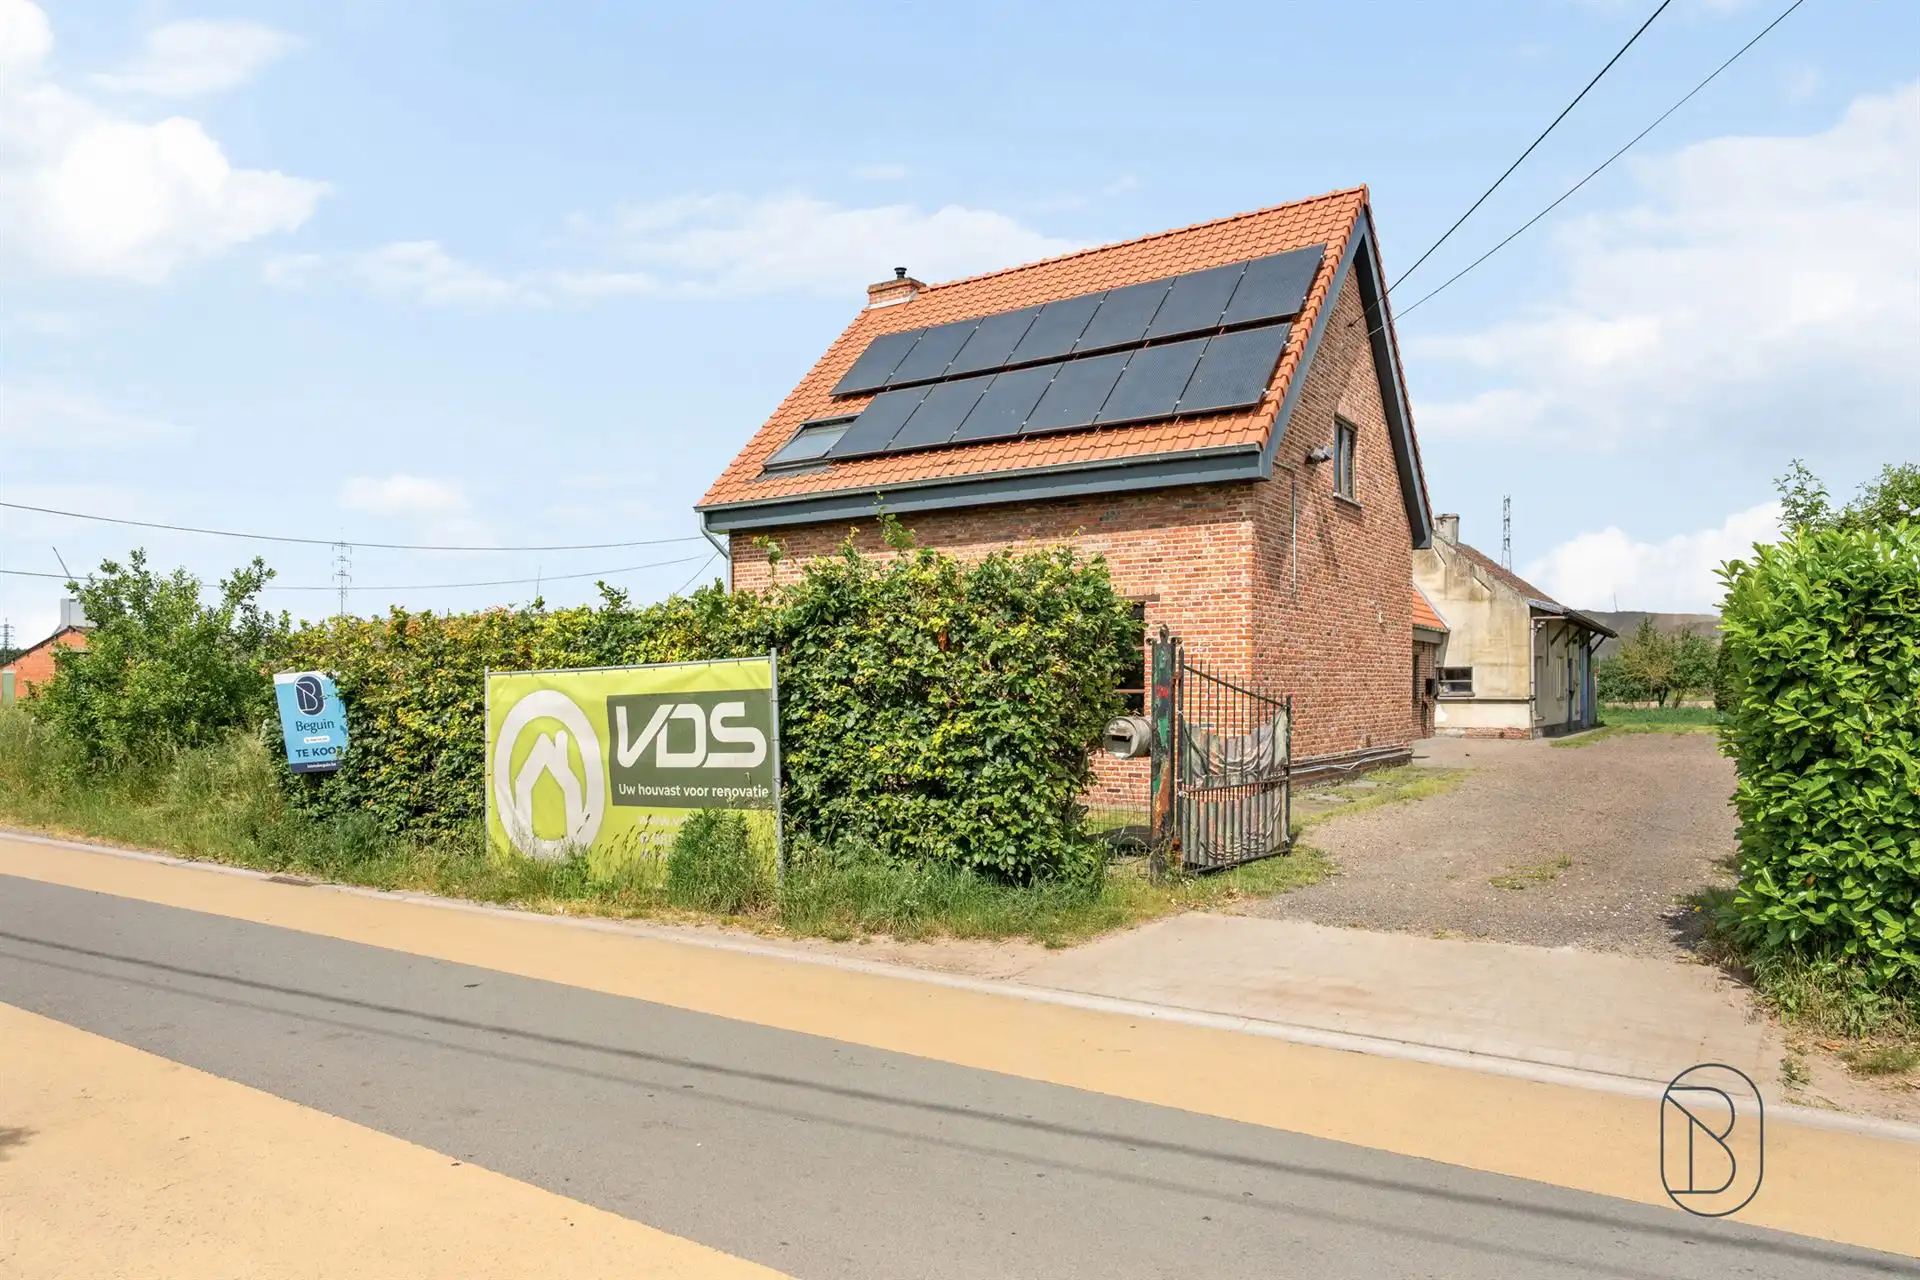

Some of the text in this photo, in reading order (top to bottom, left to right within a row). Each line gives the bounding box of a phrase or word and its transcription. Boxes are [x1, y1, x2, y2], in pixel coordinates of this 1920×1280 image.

[295, 719, 335, 734] Beguin
[616, 701, 767, 768] VDS
[295, 745, 342, 758] TE KOO
[618, 783, 769, 799] Uw houvast voor renovatie
